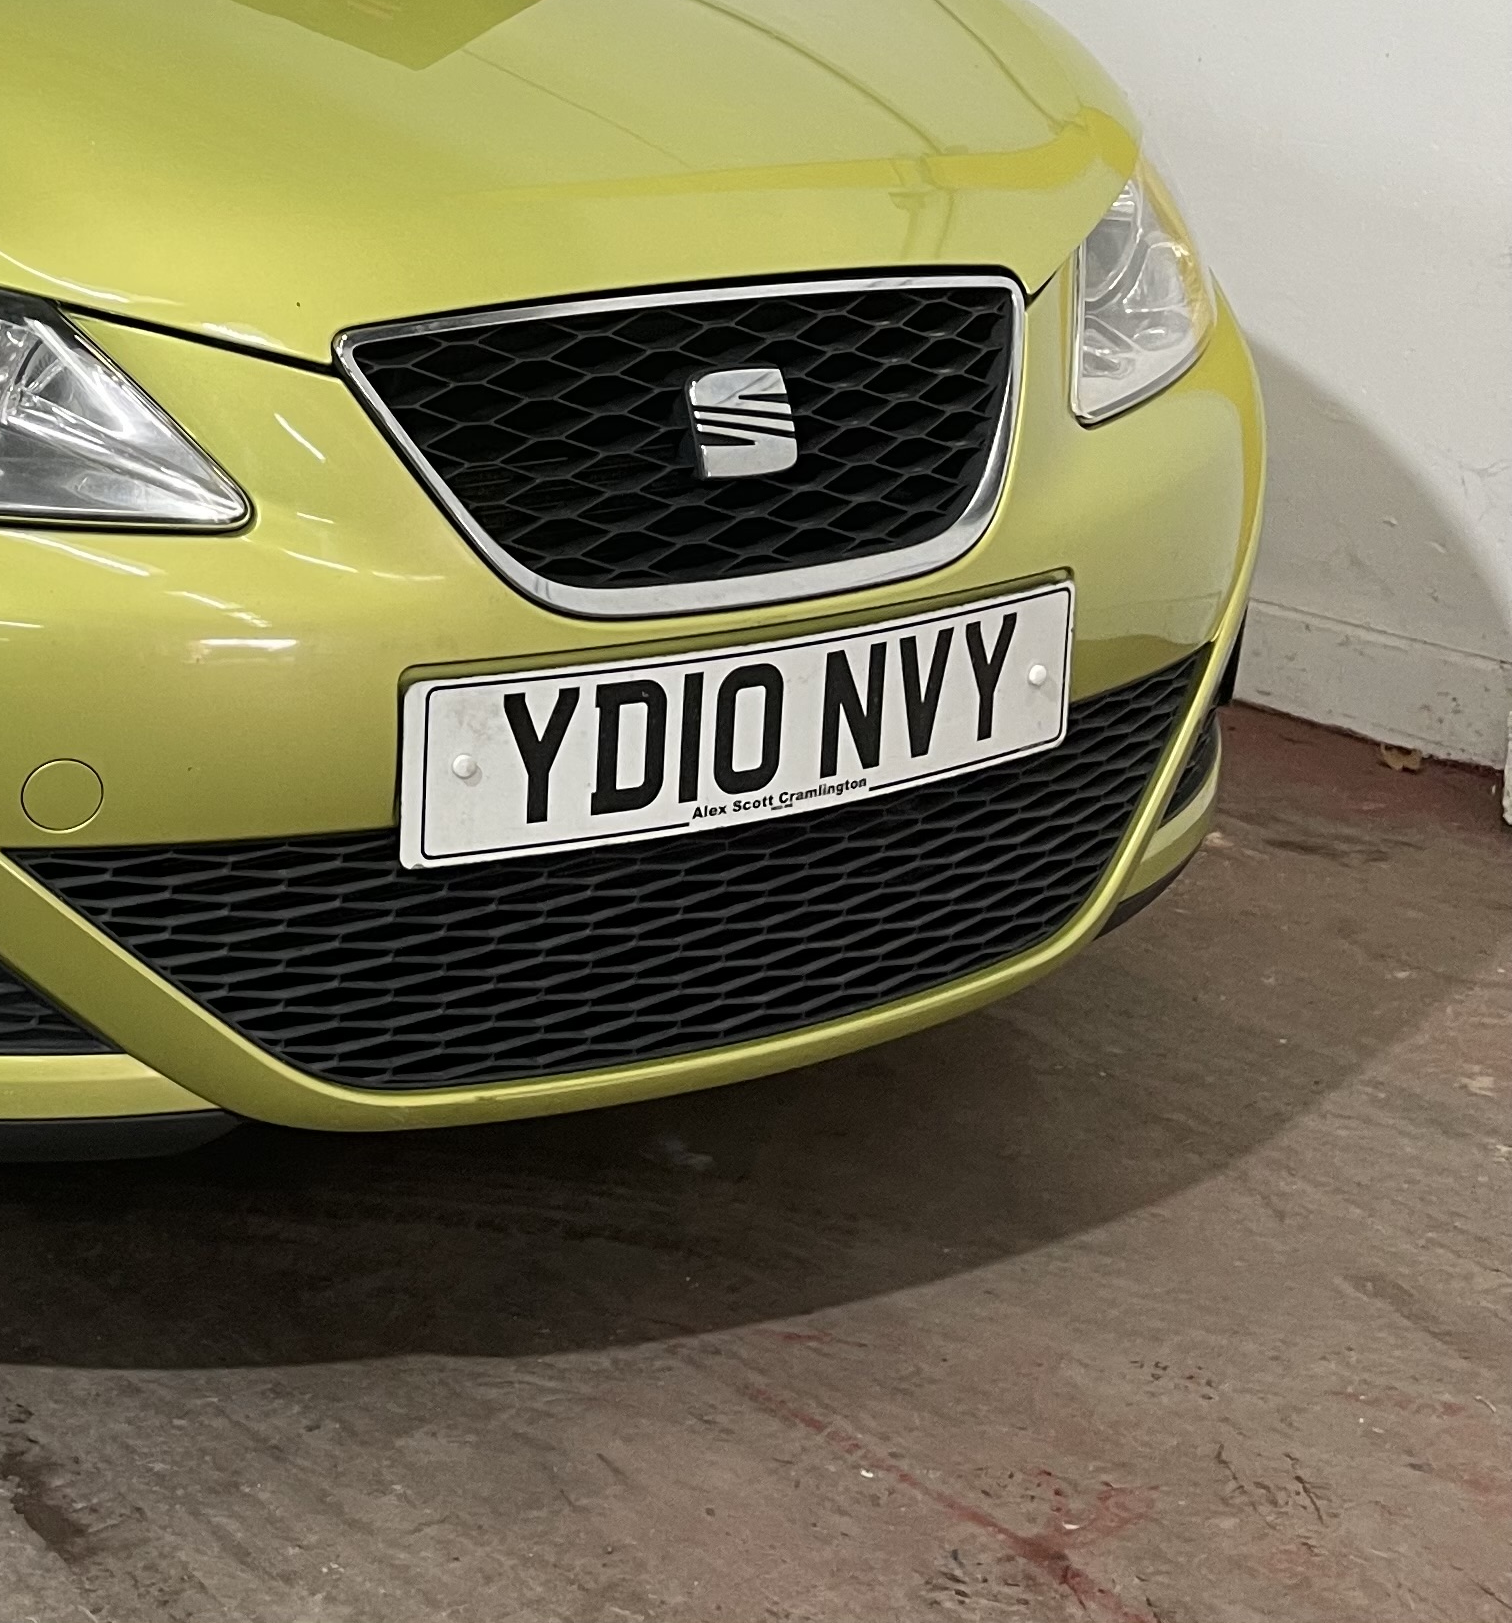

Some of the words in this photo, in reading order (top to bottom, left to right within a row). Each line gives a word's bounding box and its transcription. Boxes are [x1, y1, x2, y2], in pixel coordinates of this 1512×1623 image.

[503, 664, 784, 824] YD10
[820, 612, 1017, 778] NVY
[692, 804, 727, 819] Alex
[732, 795, 774, 813] Scott
[778, 778, 867, 804] Cramlington
